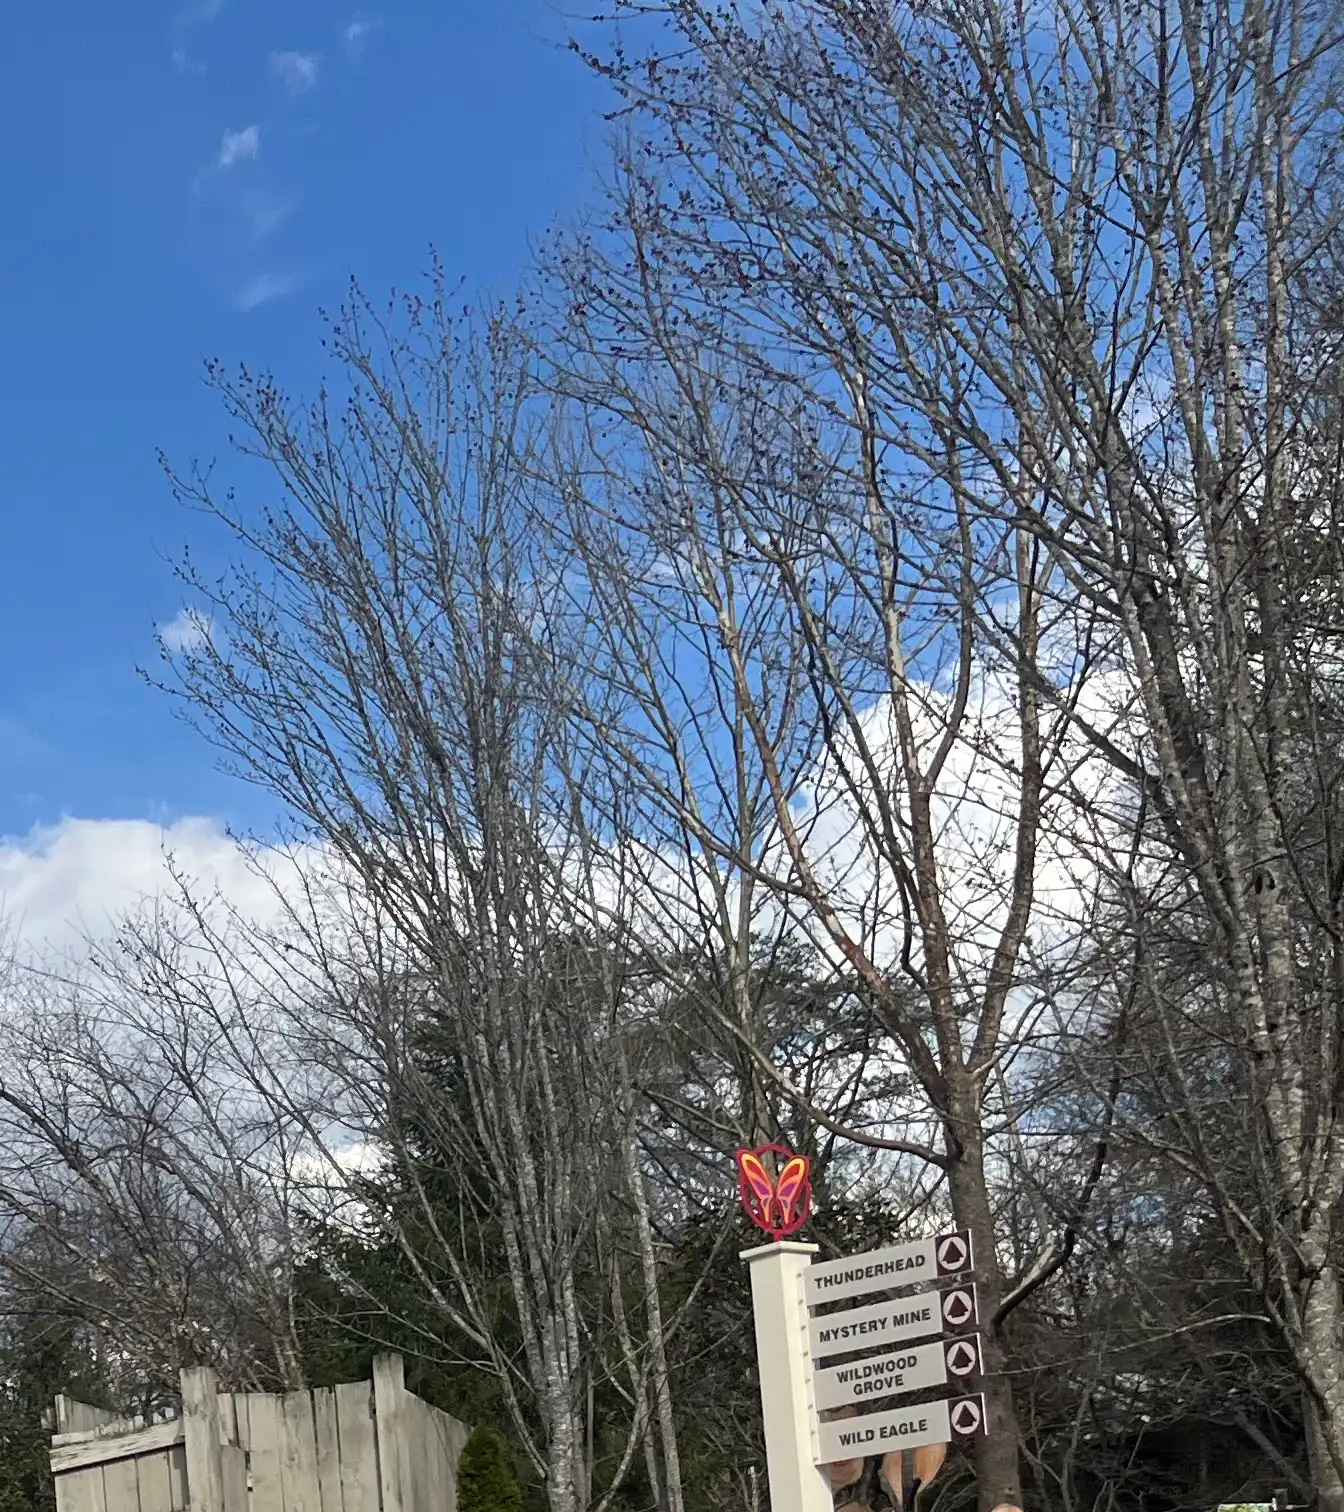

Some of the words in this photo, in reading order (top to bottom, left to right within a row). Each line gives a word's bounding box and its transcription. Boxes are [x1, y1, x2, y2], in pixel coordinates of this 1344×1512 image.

[814, 1255, 926, 1289] THUNDERHEAD
[819, 1317, 888, 1343] MYSTERY
[893, 1307, 931, 1328] MINE
[836, 1355, 918, 1384] WILDWOOD
[853, 1374, 904, 1396] GROVE
[839, 1429, 875, 1447] WILD
[879, 1419, 928, 1440] EAGLE
